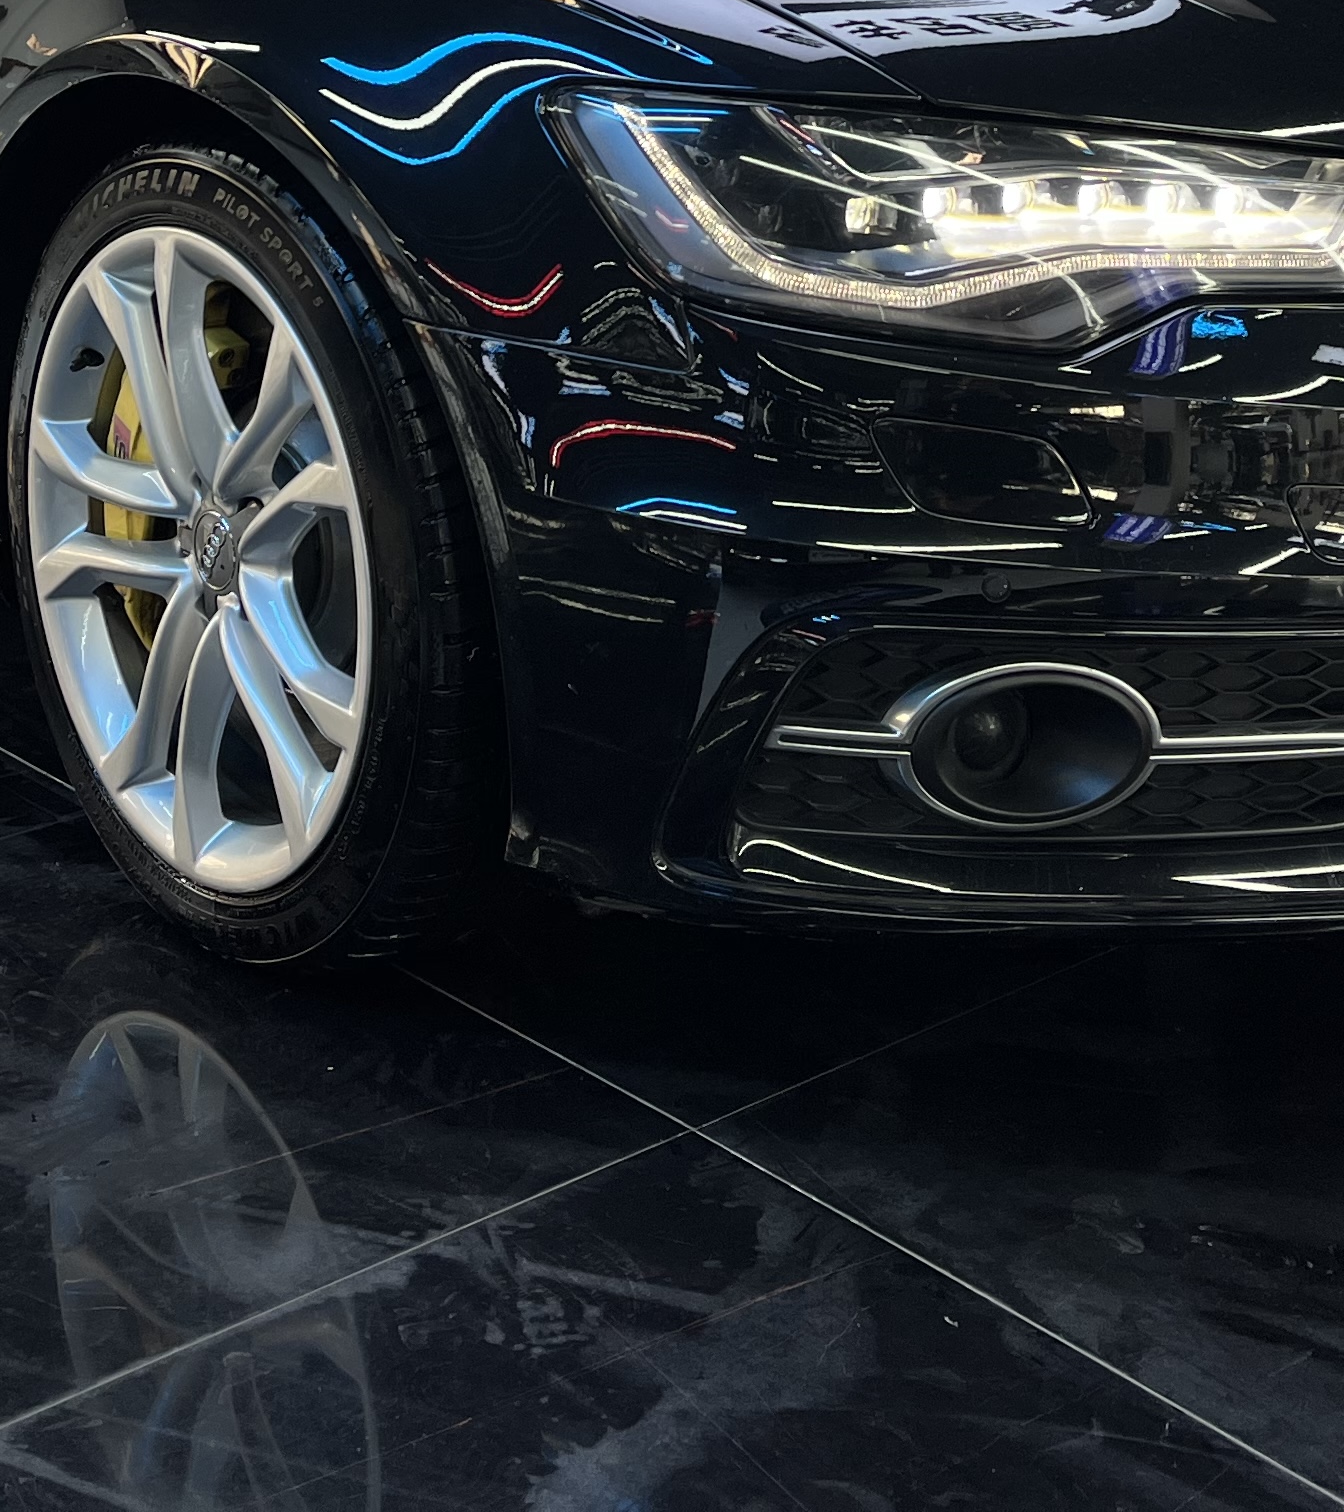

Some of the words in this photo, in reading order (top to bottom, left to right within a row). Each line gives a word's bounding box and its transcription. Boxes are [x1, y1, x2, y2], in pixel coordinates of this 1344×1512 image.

[73, 168, 201, 228] MICHELIN
[212, 188, 261, 229] PILOT
[259, 227, 314, 291] SPORT
